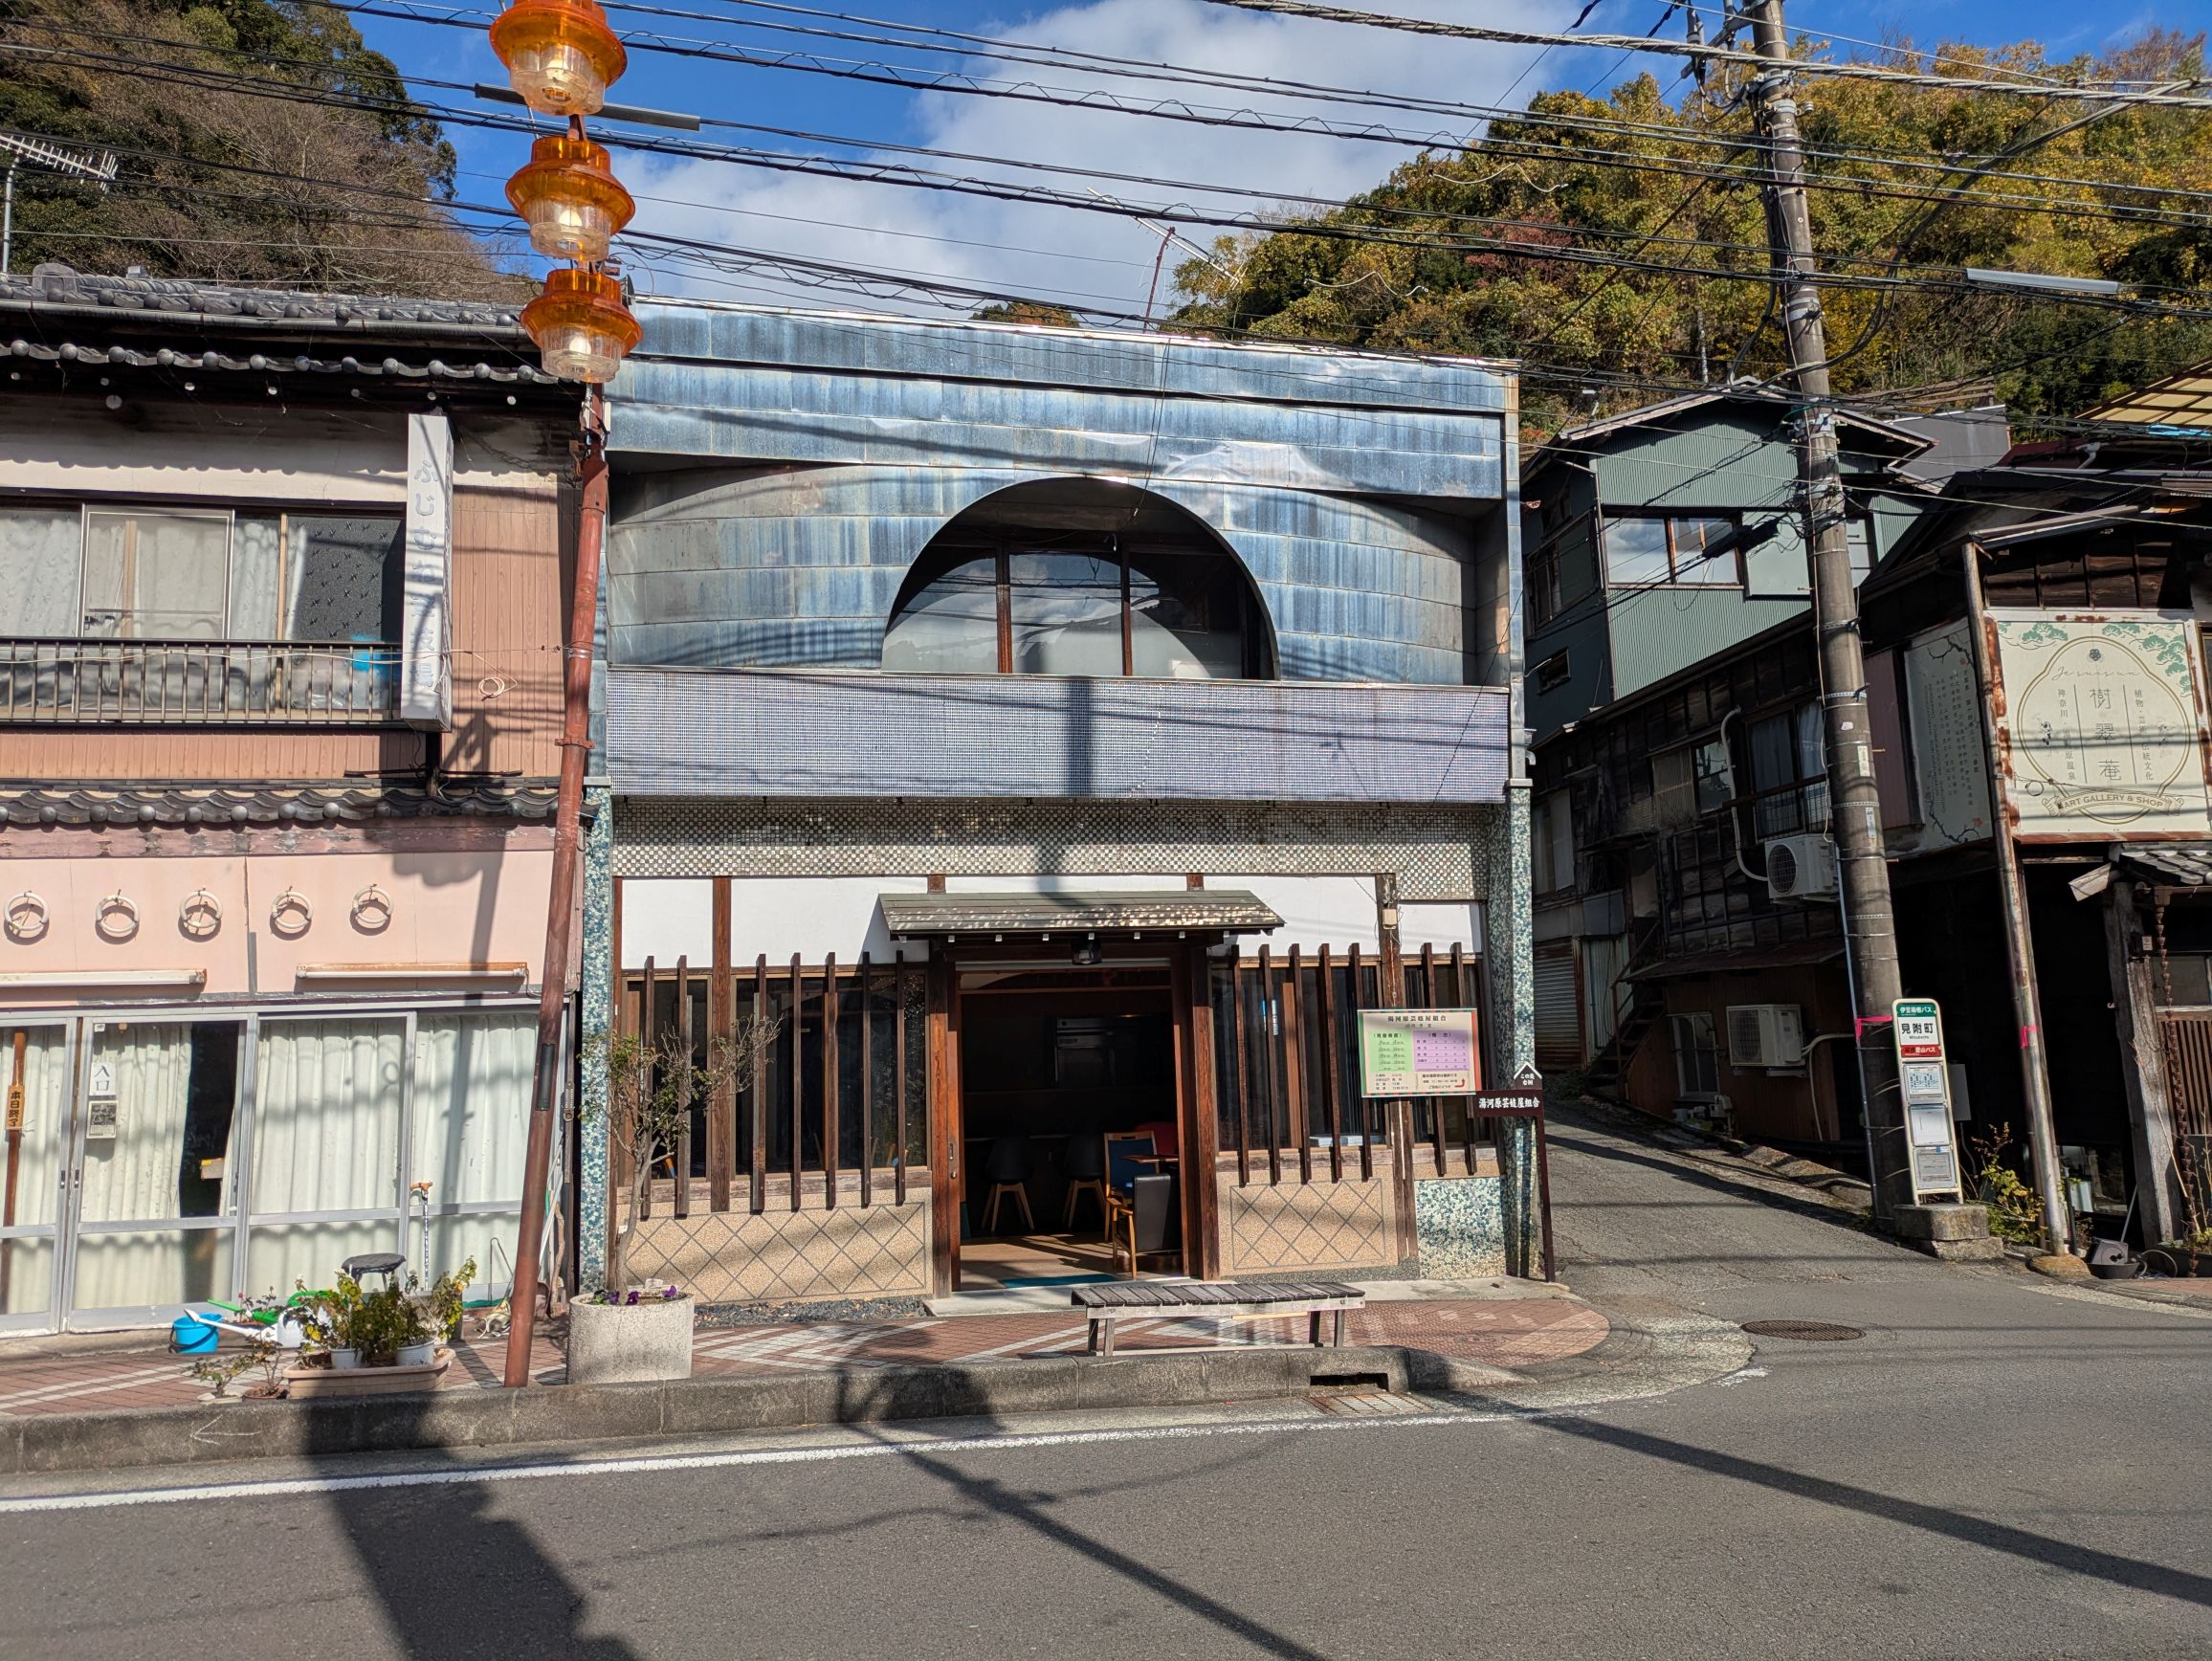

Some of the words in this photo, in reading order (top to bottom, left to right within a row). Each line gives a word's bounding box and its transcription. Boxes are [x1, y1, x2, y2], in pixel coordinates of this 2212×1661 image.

[2051, 666, 2073, 681] Je
[2064, 798, 2081, 808] ART
[2083, 794, 2125, 803] GALLERY
[2135, 796, 2163, 808] SHOP
[1901, 1023, 1934, 1034] 見附町
[94, 1064, 110, 1091] 入口
[8, 1091, 21, 1127] 本日終了
